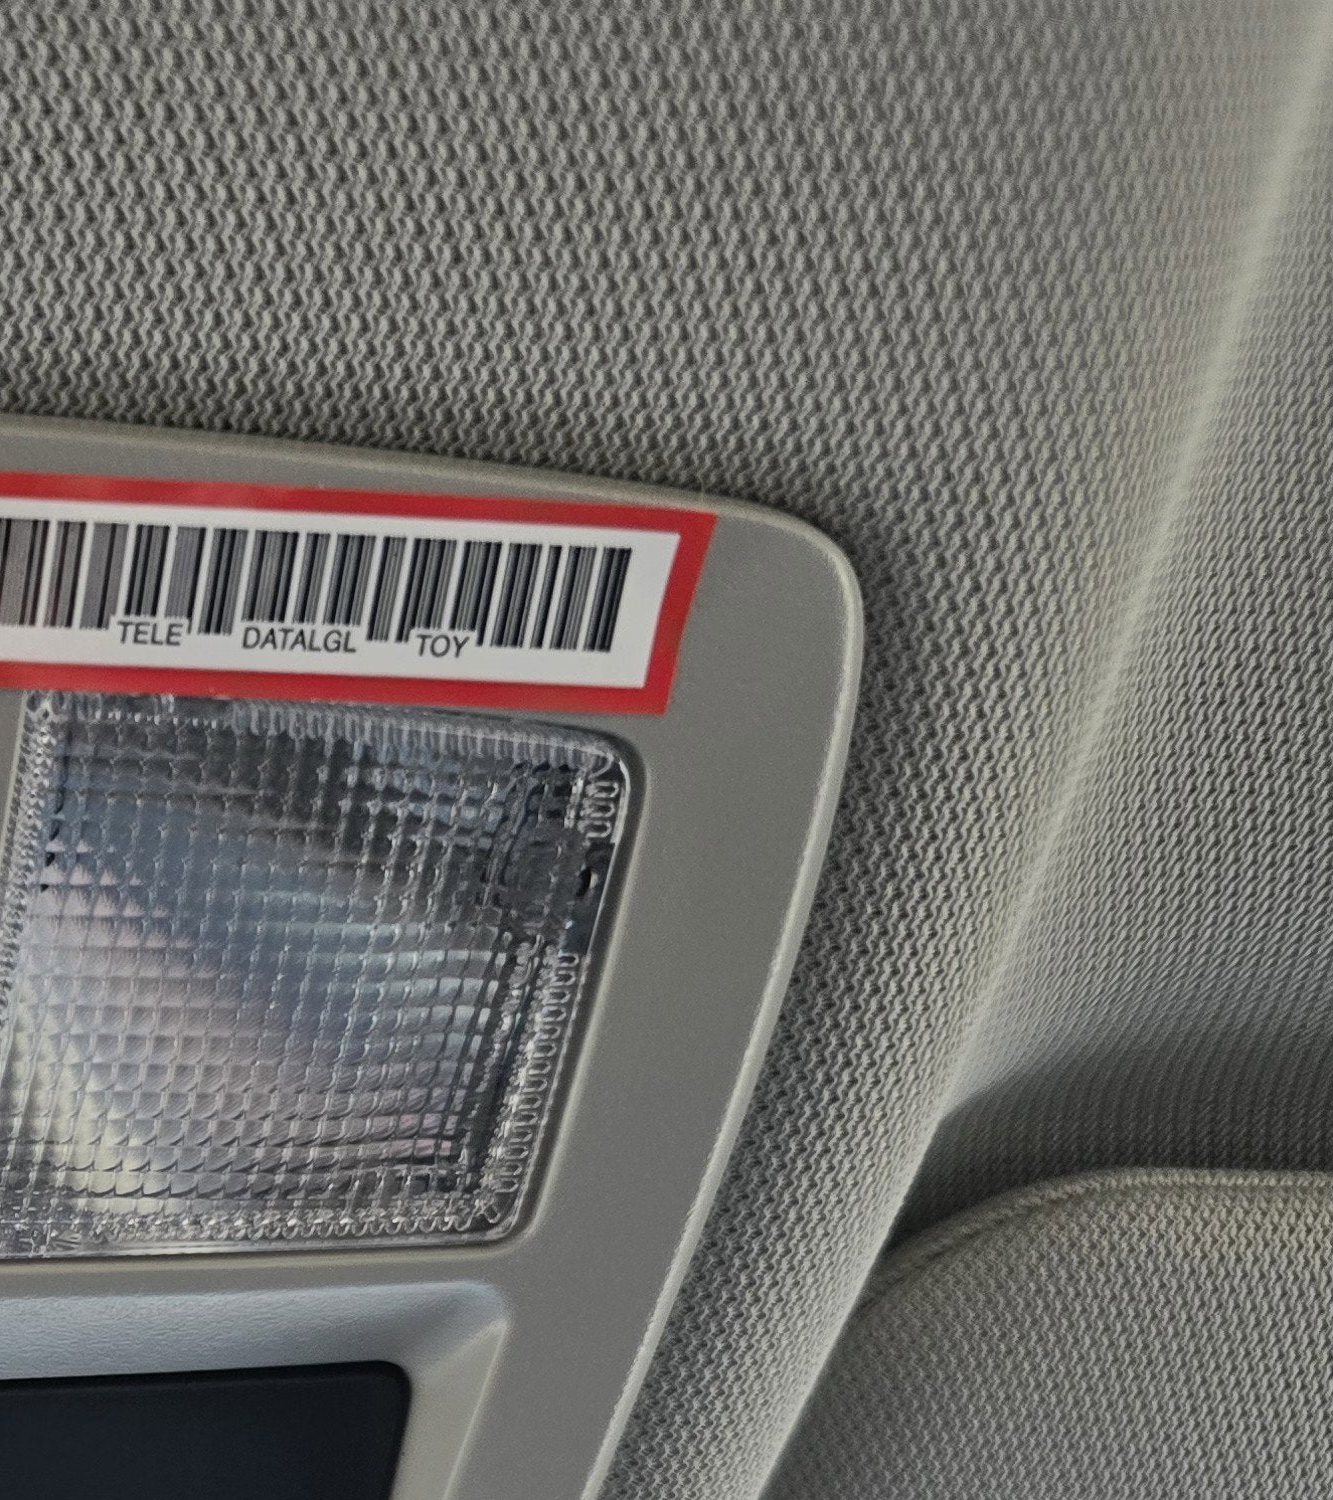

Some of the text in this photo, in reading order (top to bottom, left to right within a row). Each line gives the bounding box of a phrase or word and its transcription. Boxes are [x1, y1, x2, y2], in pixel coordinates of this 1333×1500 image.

[117, 621, 471, 659] TELE DATALGL TOY
